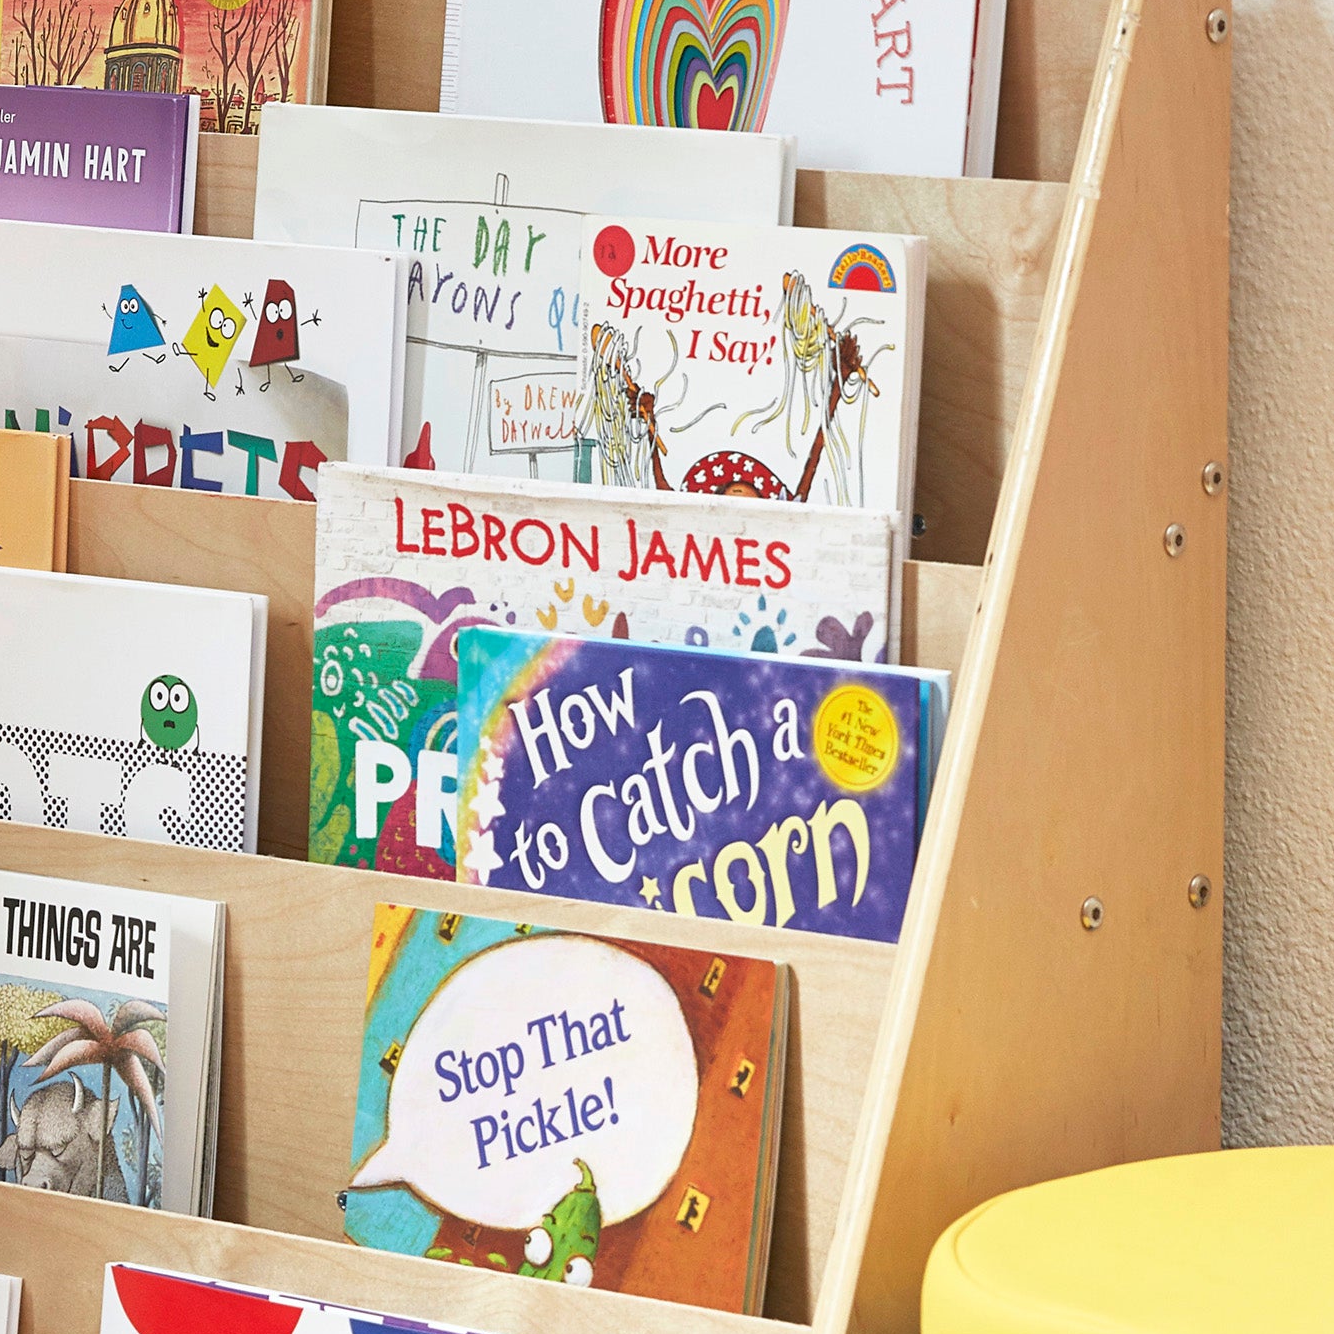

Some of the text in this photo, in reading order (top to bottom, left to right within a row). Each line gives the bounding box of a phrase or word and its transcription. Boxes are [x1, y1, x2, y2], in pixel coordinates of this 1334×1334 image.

[83, 144, 147, 184] HART
[392, 214, 547, 276] THE DAY
[641, 235, 728, 270] More
[606, 277, 771, 323] Spaghetti,
[686, 329, 777, 375] I Say!
[525, 384, 576, 411] DREW
[618, 519, 791, 589] JAMES
[508, 667, 805, 789] How a
[510, 689, 760, 890] to Catch
[653, 798, 870, 928] corn
[3, 897, 101, 969] THINGS
[109, 915, 157, 980] ARE
[434, 998, 631, 1103] Stop That
[470, 1076, 620, 1169] Pickle!
